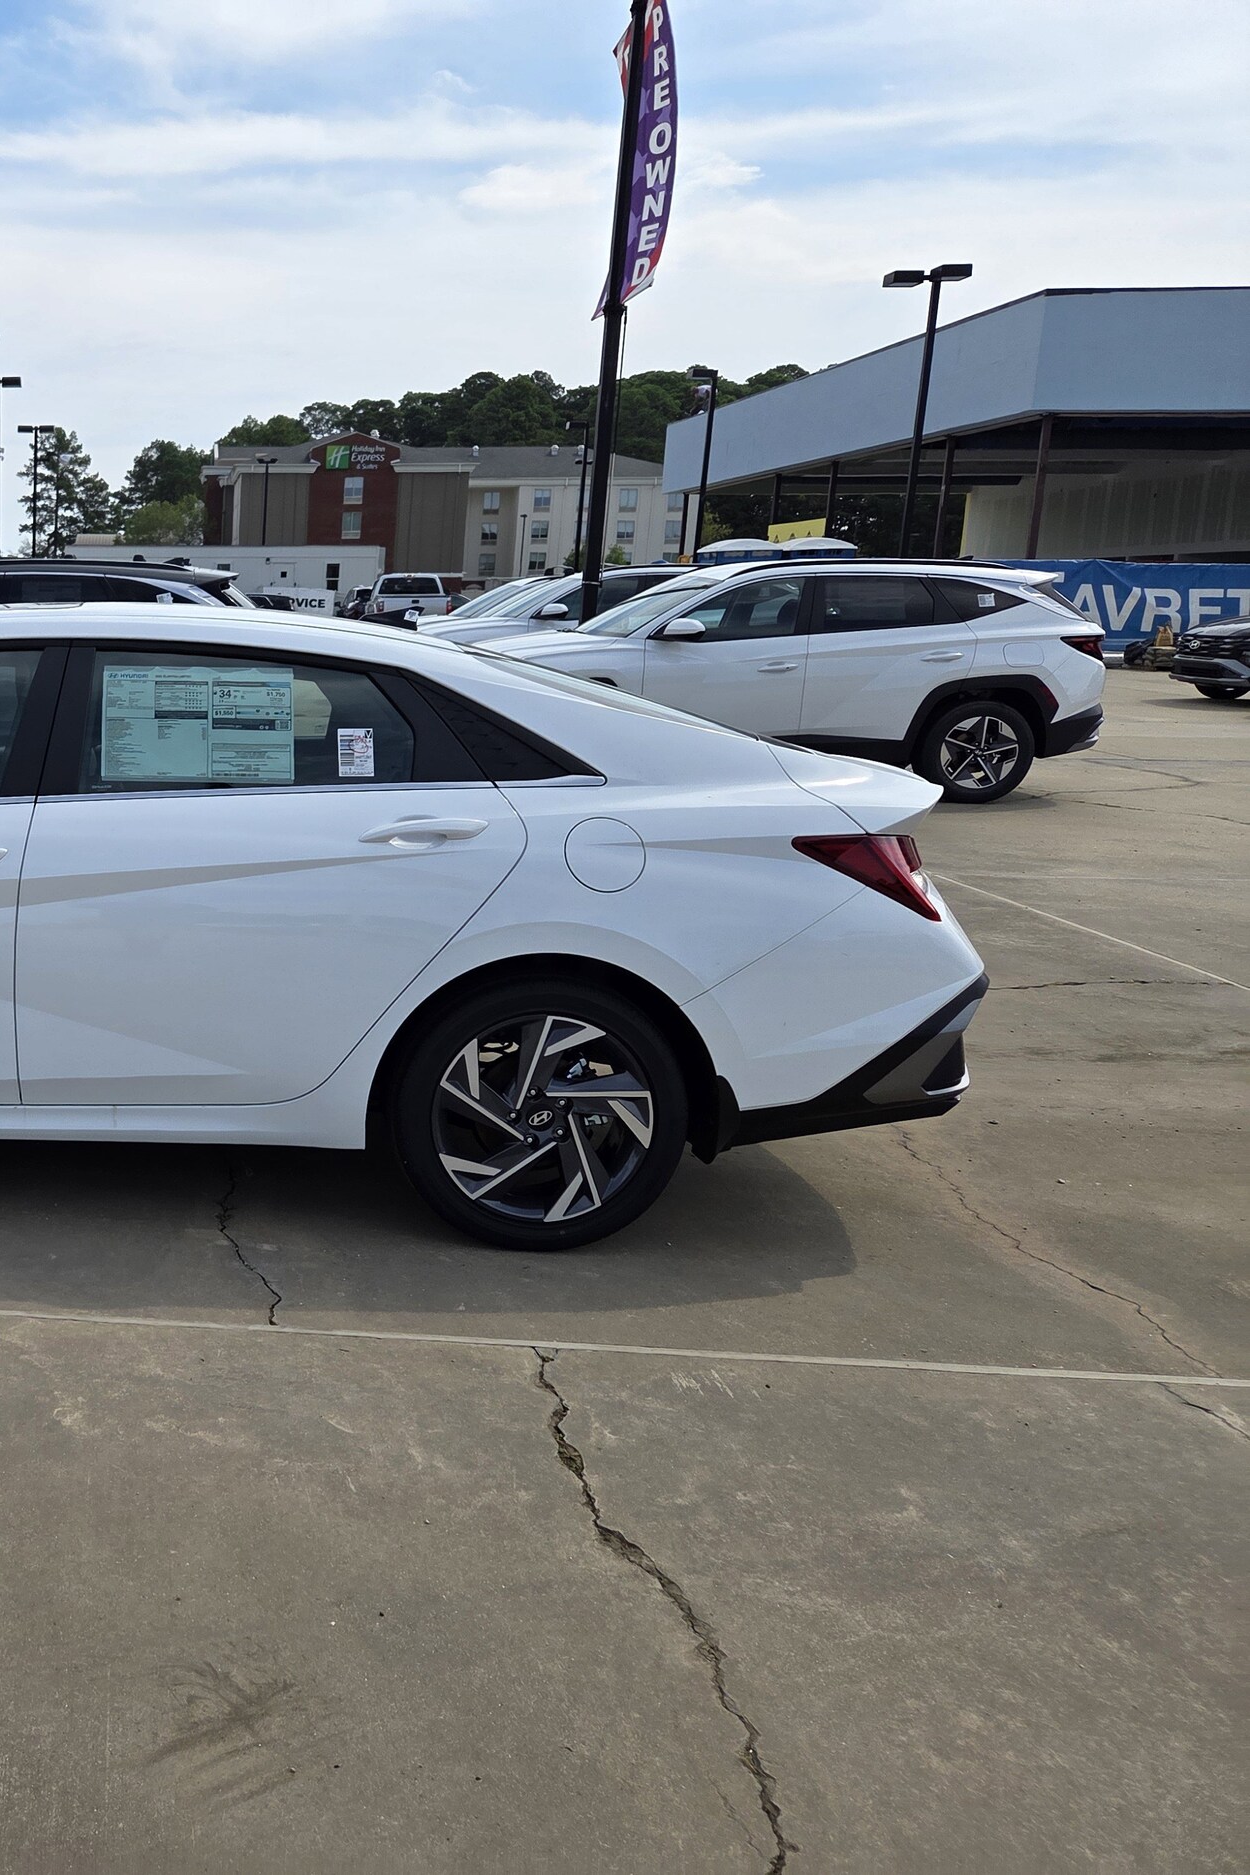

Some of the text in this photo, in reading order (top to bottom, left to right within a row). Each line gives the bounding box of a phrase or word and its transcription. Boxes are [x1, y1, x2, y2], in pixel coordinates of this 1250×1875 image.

[631, 5, 672, 288] PRE OWNED
[351, 445, 375, 453] Holiday
[351, 453, 385, 463] Express
[218, 689, 232, 699] 34
